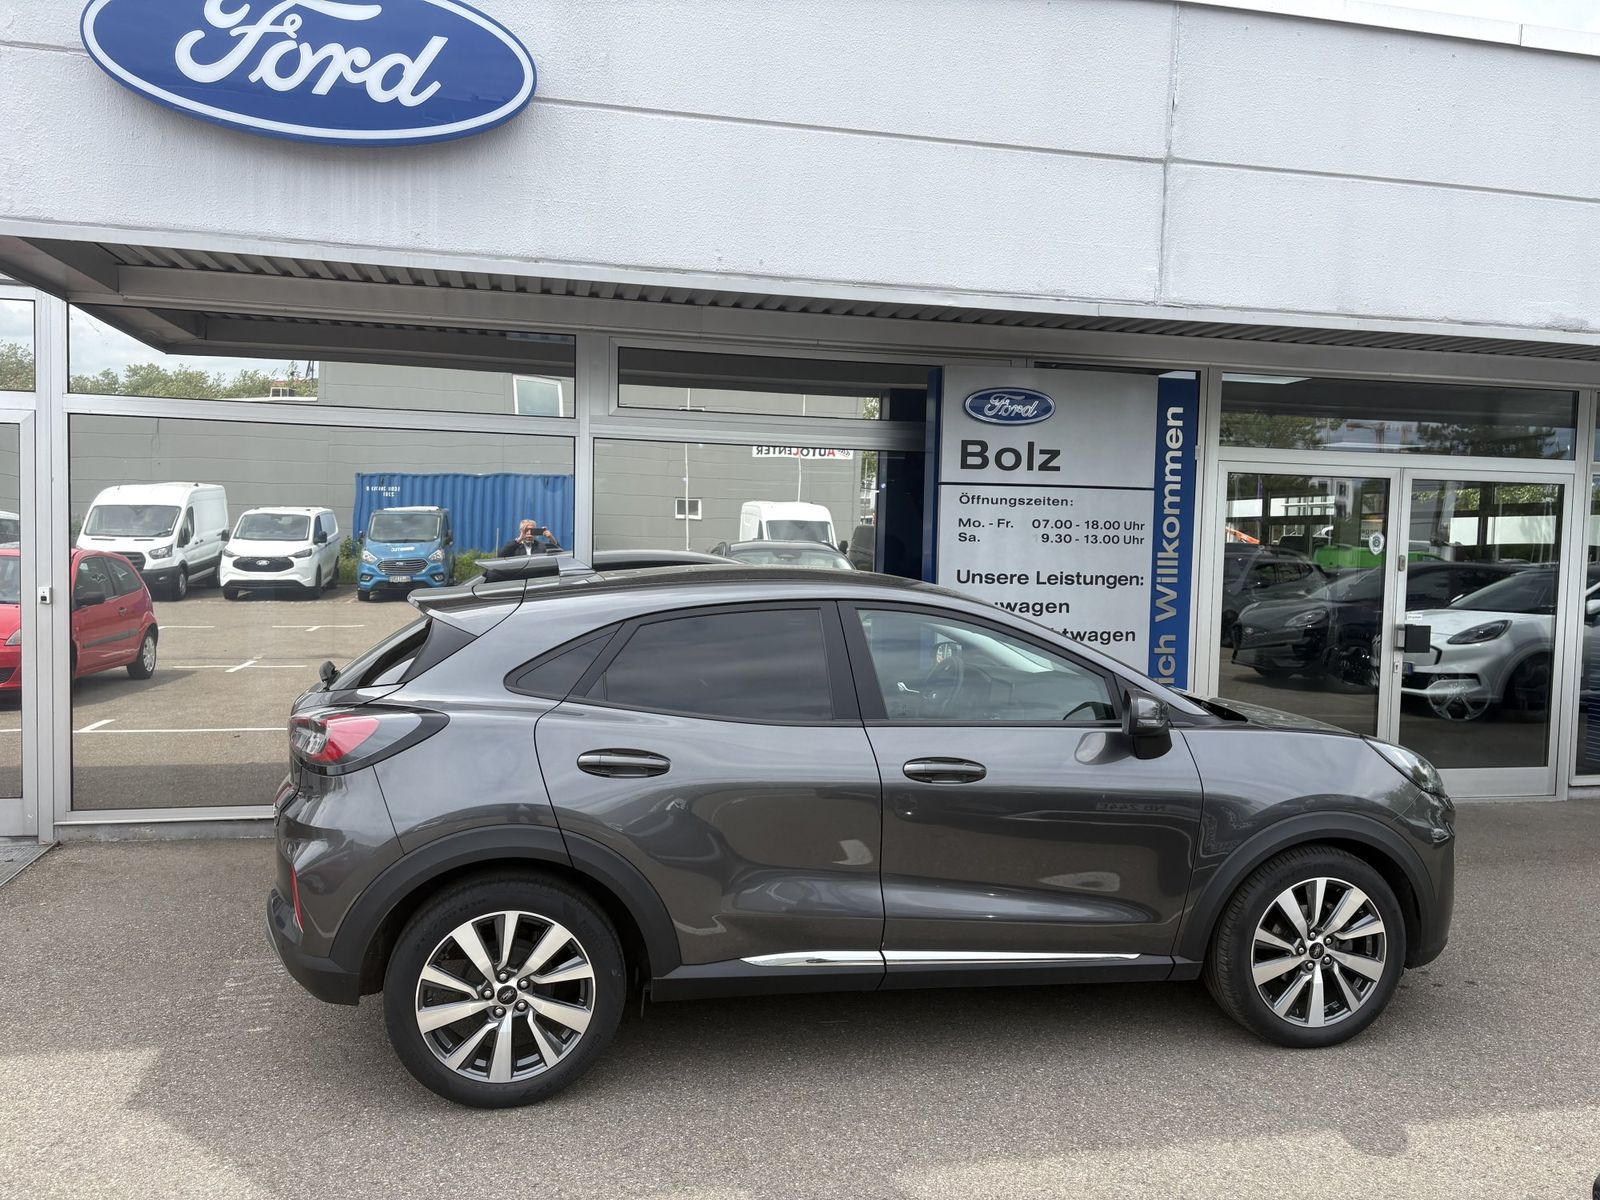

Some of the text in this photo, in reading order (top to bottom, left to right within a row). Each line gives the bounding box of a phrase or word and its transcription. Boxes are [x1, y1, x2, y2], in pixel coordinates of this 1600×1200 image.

[175, 0, 449, 107] Ford
[984, 393, 1039, 418] Ford
[960, 439, 1061, 472] Bolz
[959, 492, 1074, 508] Öffnungszeiten:
[1154, 406, 1184, 623] Willkommen
[958, 517, 985, 528] Mo.
[997, 518, 1014, 528] Fr.
[1032, 519, 1072, 530] 07.00
[1085, 520, 1120, 531] 18.00
[1124, 521, 1145, 531] Uhr
[958, 532, 981, 543] Sa.
[1041, 533, 1072, 544] 9.30
[1084, 534, 1120, 545] 13.00
[1123, 535, 1145, 545] Uhr
[956, 569, 1144, 589] Unsere Leistungen:
[995, 602, 1070, 617] wagen
[1051, 628, 1136, 645] twagen
